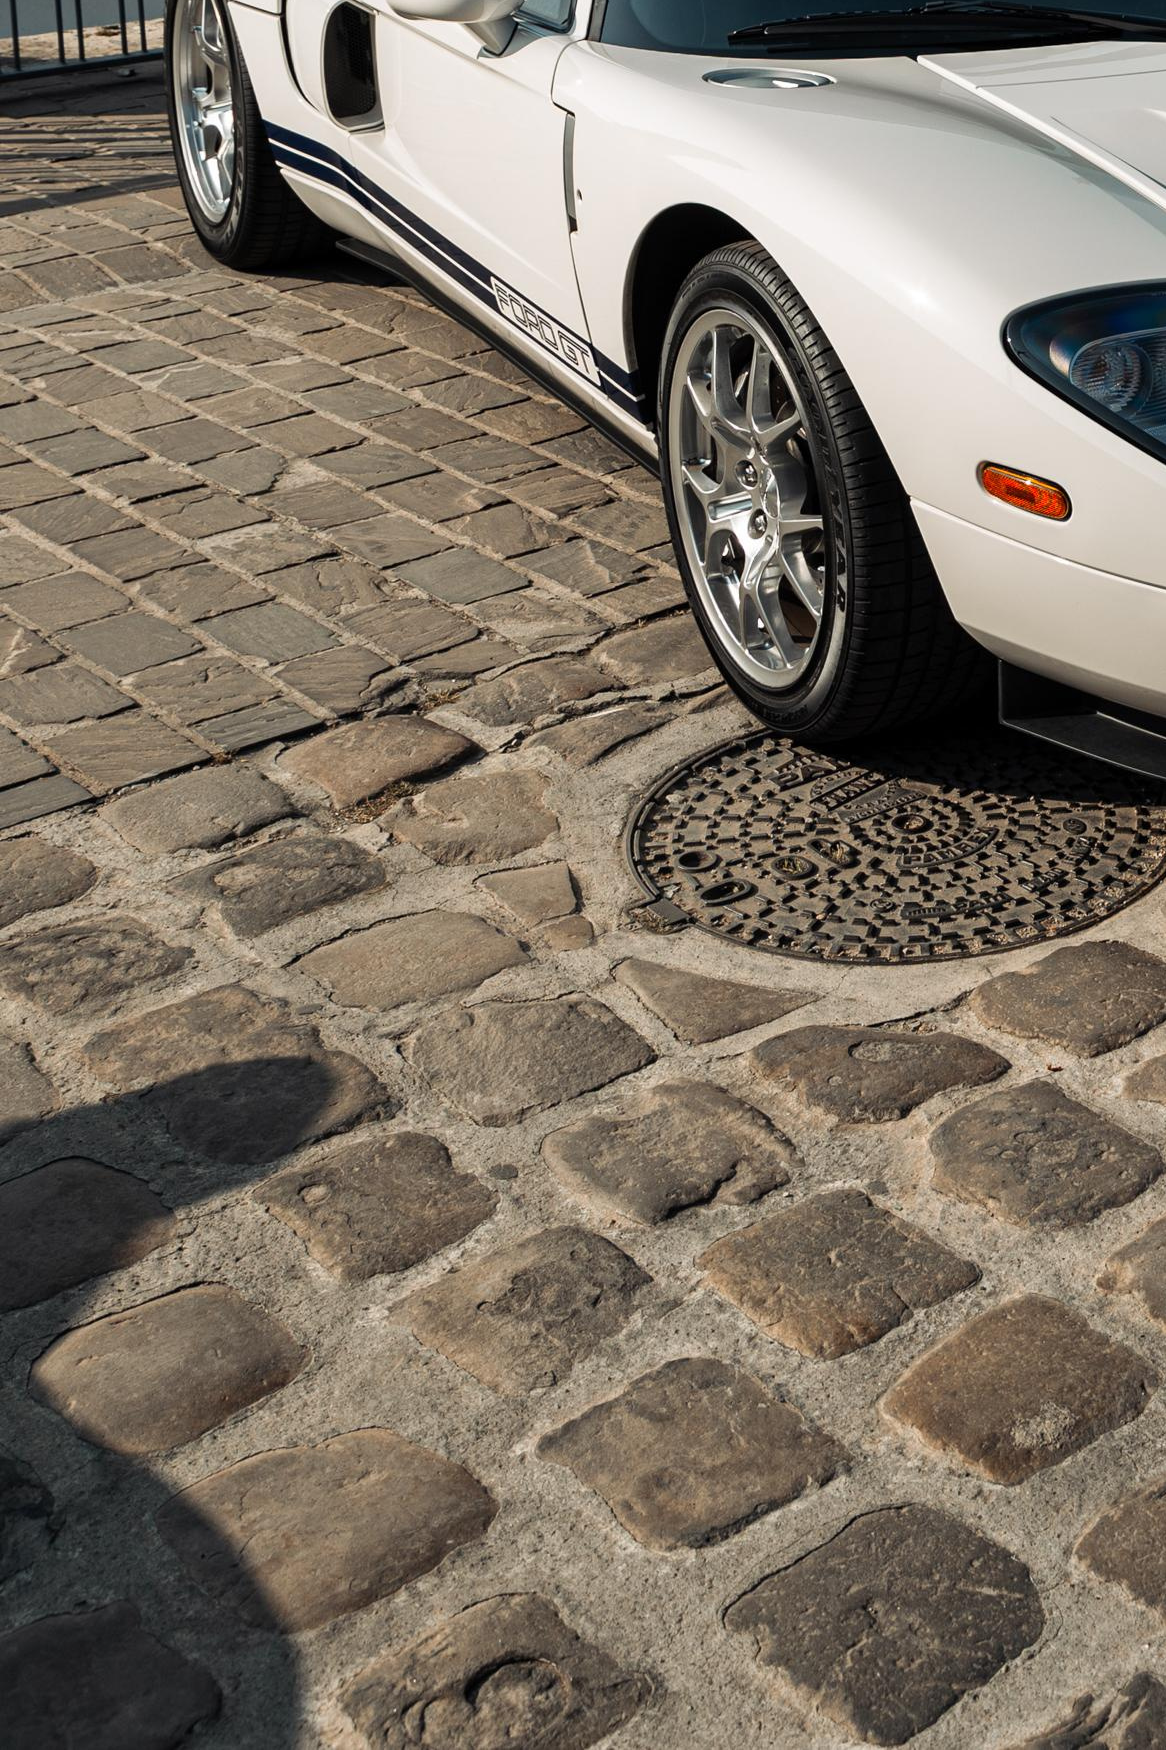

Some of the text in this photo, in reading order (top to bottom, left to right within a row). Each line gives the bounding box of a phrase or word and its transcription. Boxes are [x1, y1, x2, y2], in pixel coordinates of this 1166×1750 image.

[493, 282, 591, 375] FORD GT
[901, 827, 995, 865] PAMREX
